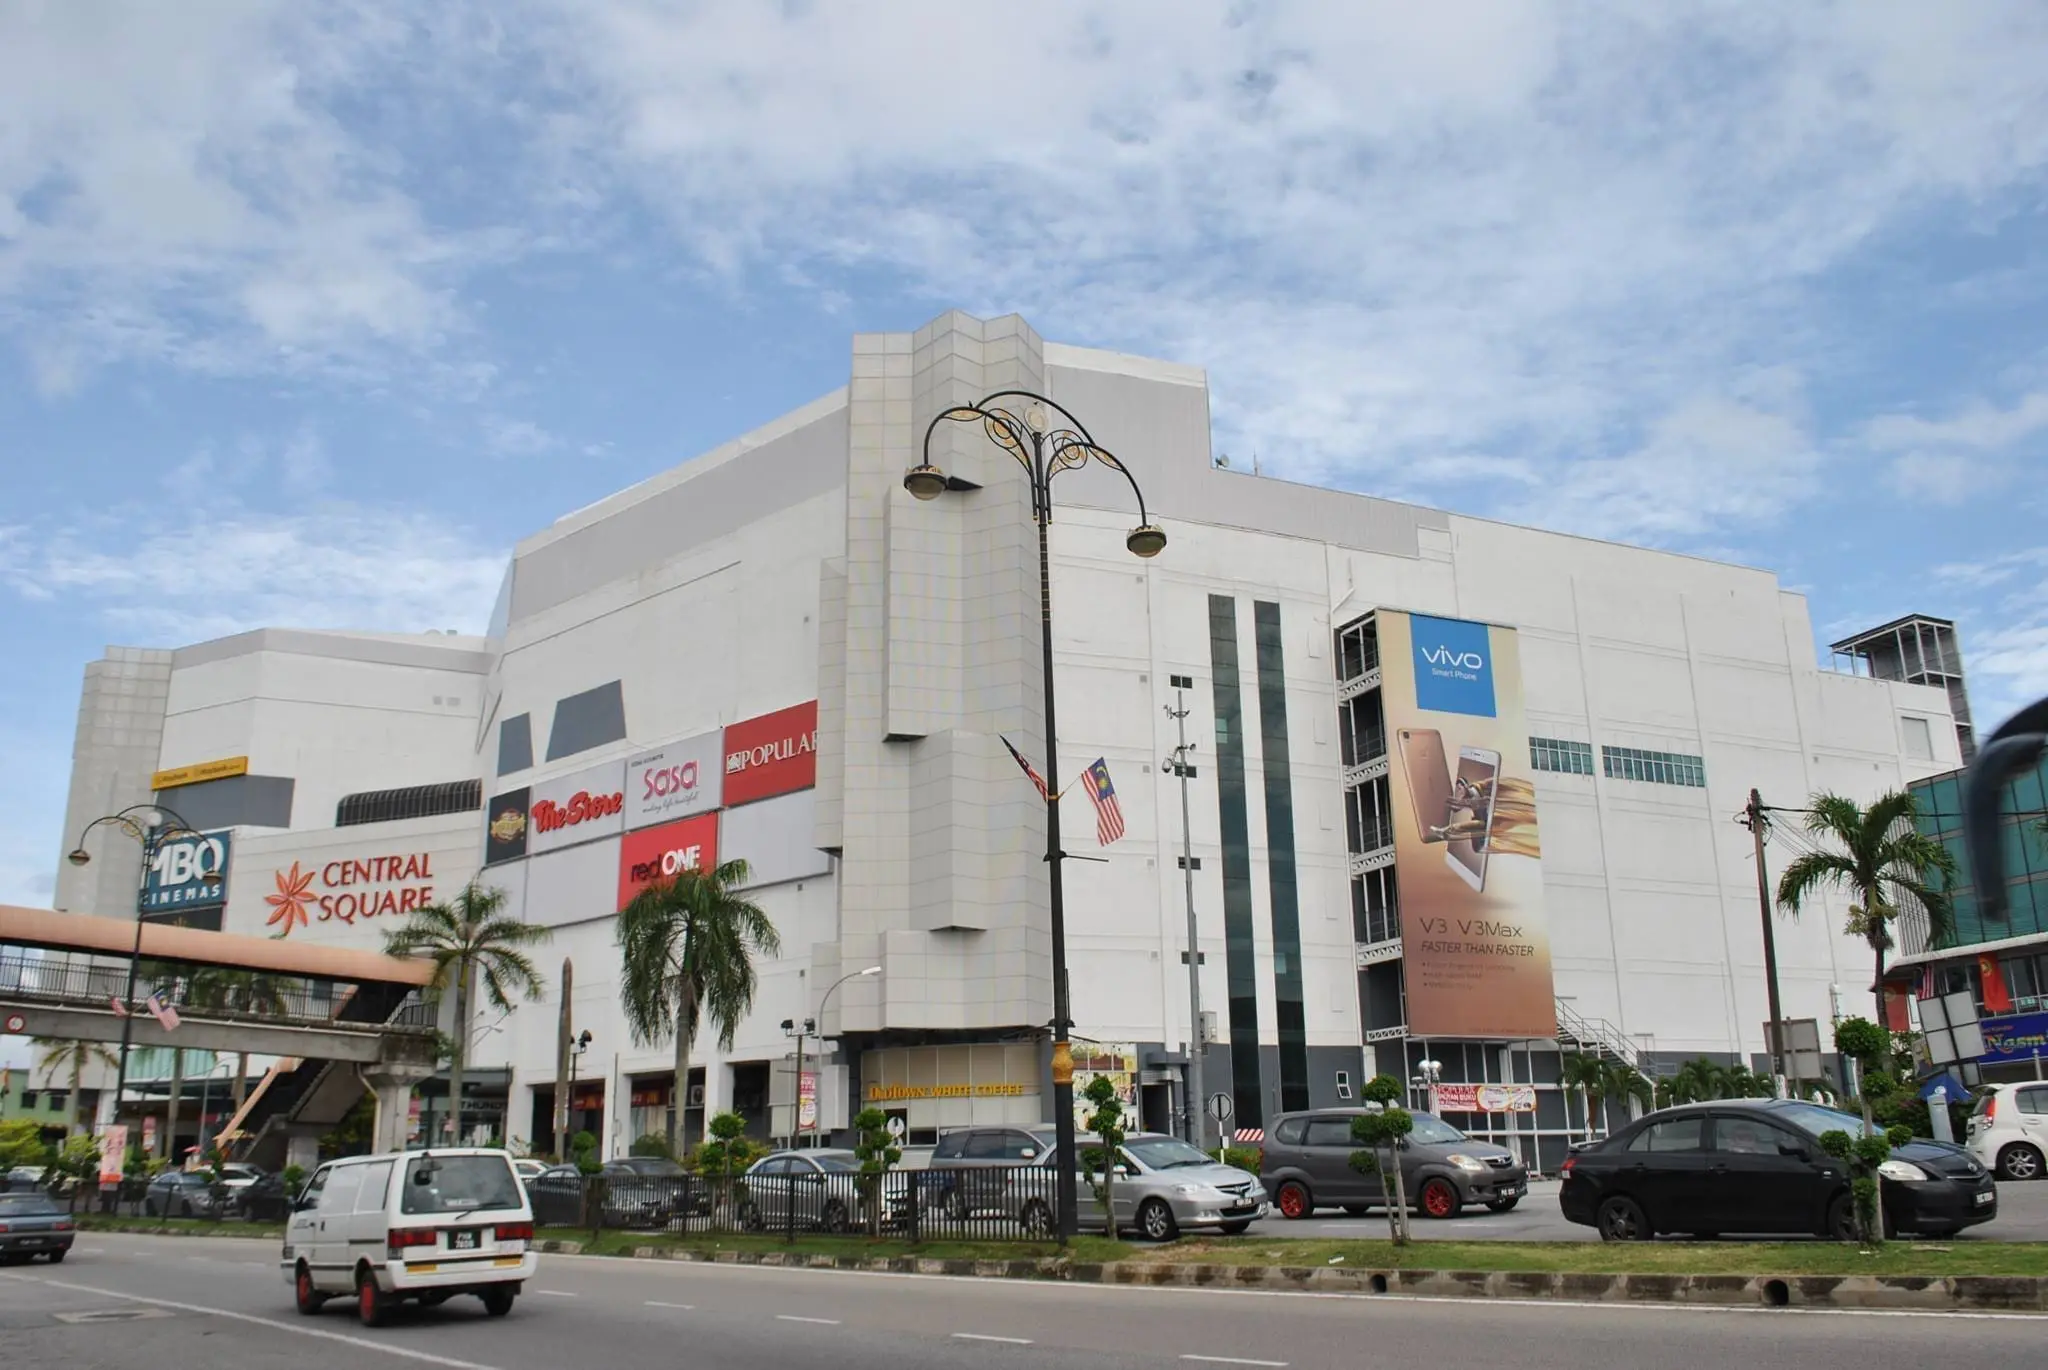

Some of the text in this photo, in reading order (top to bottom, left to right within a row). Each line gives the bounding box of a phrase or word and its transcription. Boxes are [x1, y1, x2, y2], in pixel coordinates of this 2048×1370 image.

[1421, 645, 1482, 669] vivo
[1432, 667, 1477, 682] Smart Phone
[531, 800, 567, 834] The
[566, 791, 623, 825] Store
[323, 853, 433, 888] CENTRAL
[317, 886, 433, 925] SQUARE
[1419, 917, 1523, 937] V3 V3Max
[1421, 940, 1534, 957] FASTER THAN FASTER
[931, 1084, 971, 1097] WHITE
[975, 1084, 1024, 1096] COFFEE
